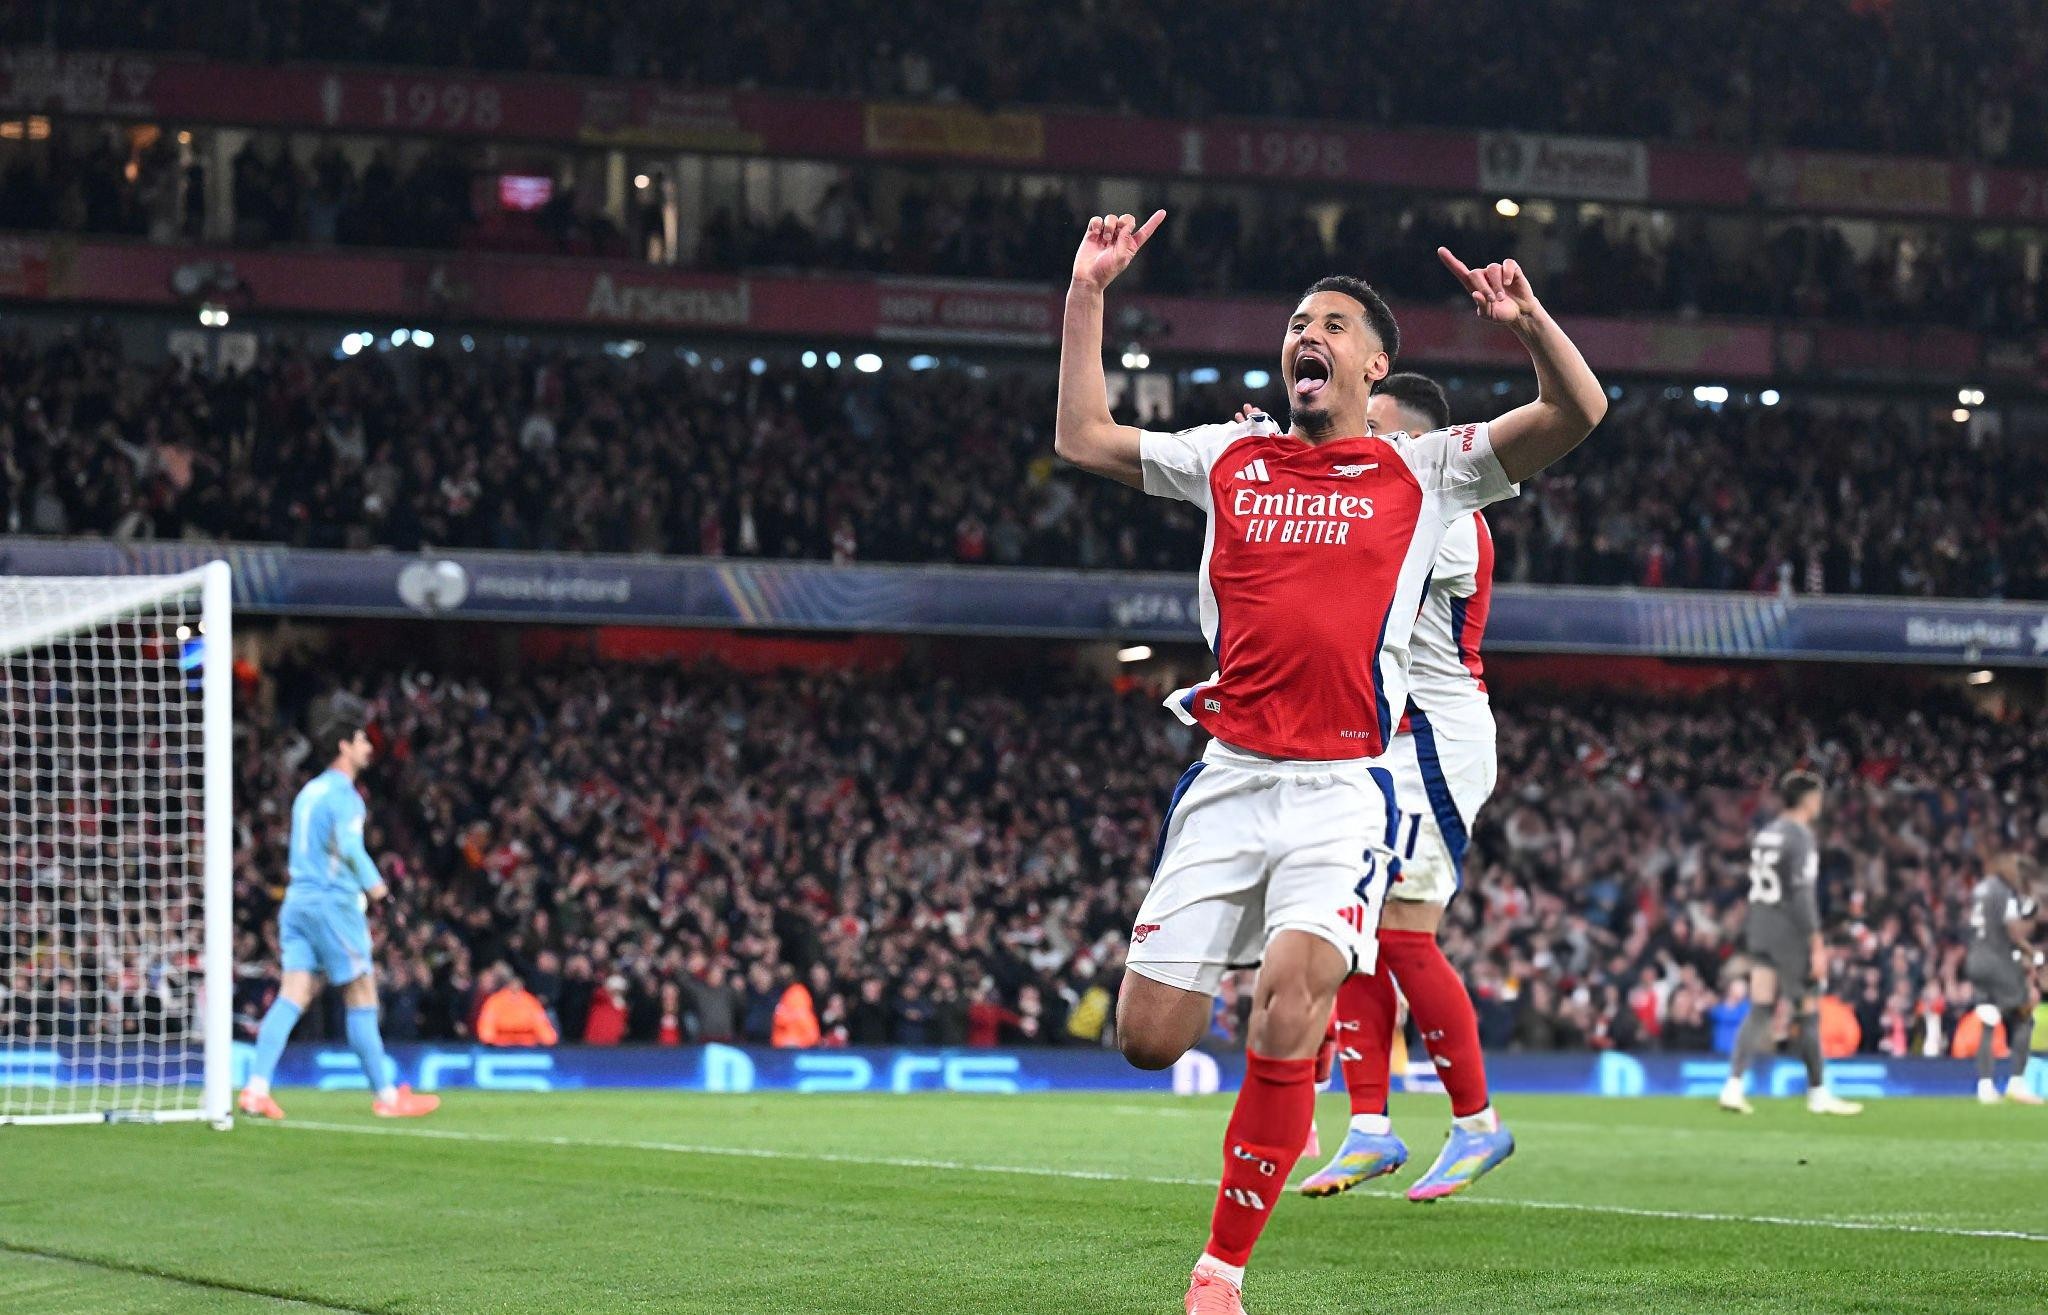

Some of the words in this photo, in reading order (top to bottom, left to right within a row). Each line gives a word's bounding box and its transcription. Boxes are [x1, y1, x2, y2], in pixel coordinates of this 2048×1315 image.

[587, 273, 748, 323] Arsenal
[1234, 487, 1374, 519] Emirates
[1245, 519, 1278, 543] FLY
[1280, 520, 1350, 545] BETTER
[1354, 849, 1376, 905] 2
